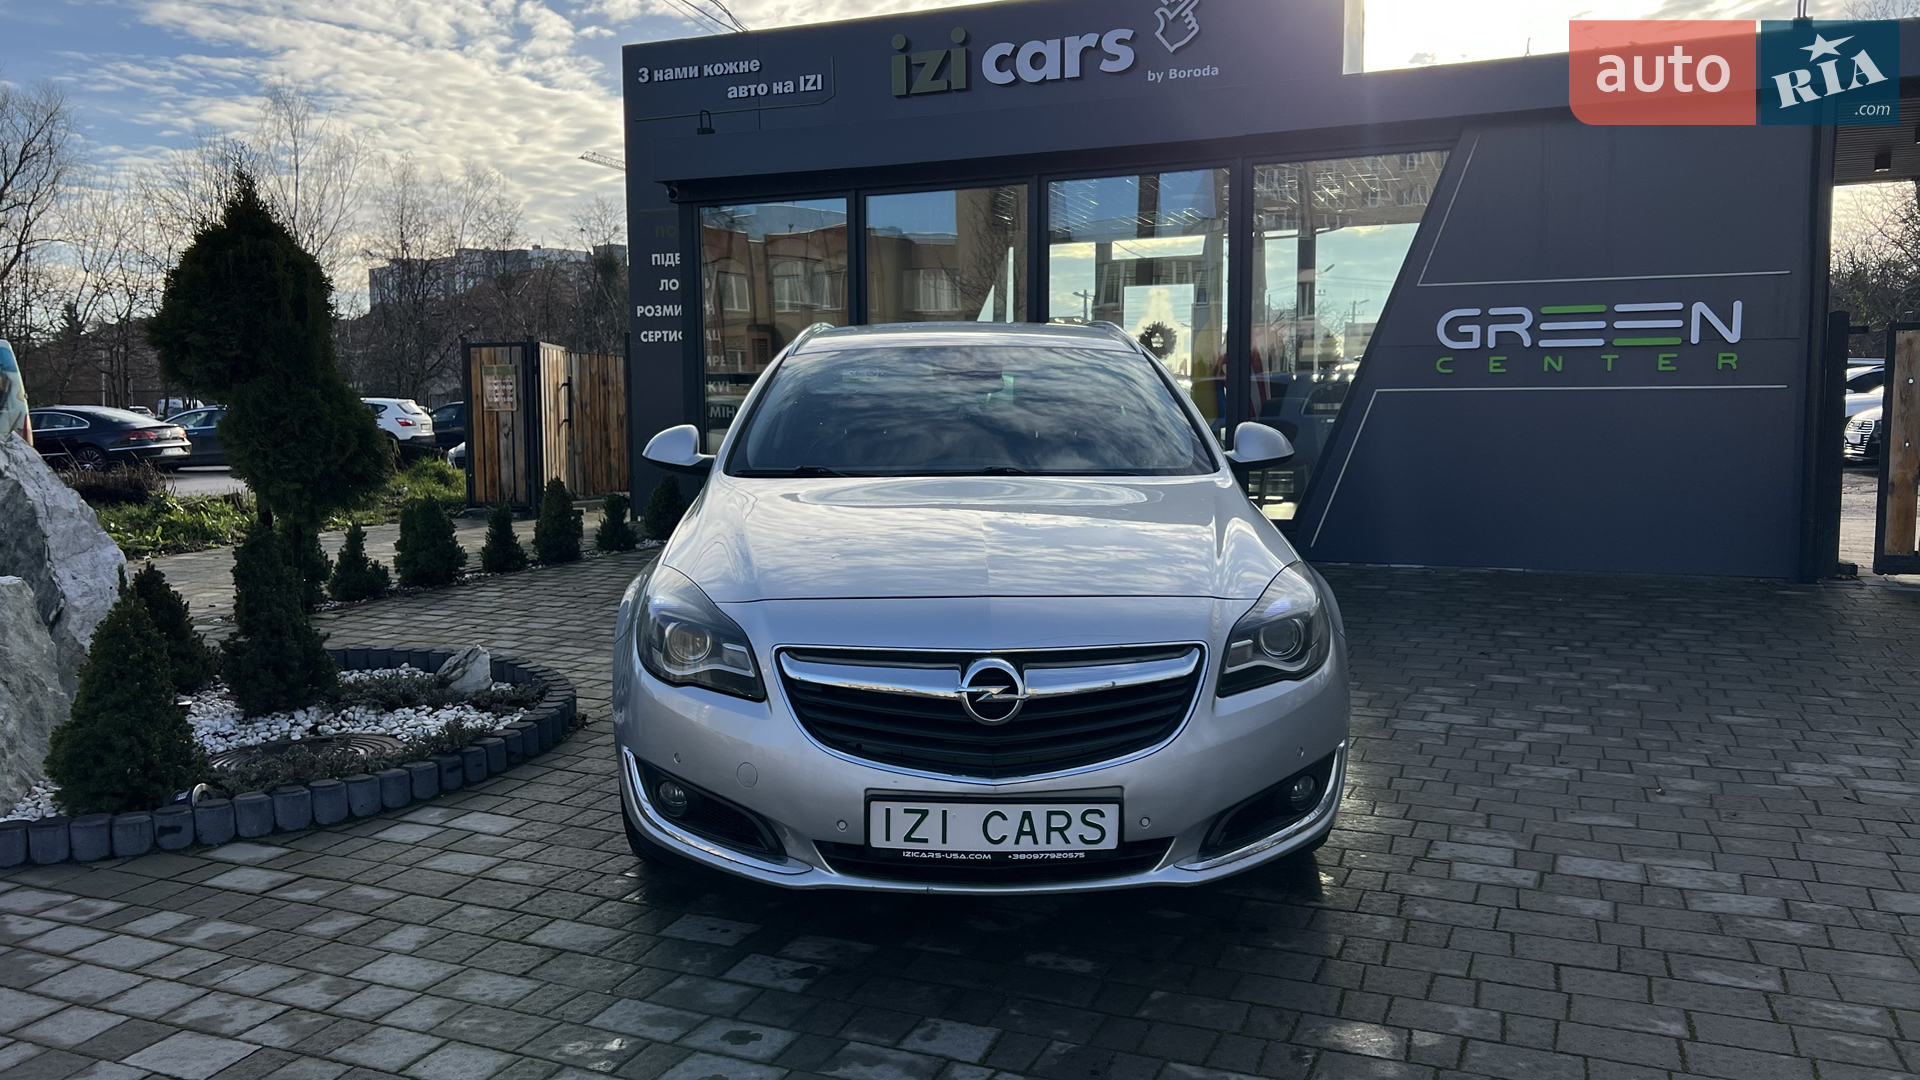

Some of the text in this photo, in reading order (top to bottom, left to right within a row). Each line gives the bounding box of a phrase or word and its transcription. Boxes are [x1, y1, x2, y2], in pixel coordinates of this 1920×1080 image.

[653, 65, 699, 82] нами
[703, 59, 761, 77] кожне
[891, 26, 1136, 96] izi cars
[1147, 64, 1219, 83] by Boroda
[727, 74, 823, 99] авто на IZI
[1436, 300, 1743, 350] GREEN
[1435, 352, 1738, 373] CENTER
[884, 807, 1106, 845] IZI CARS
[902, 851, 992, 860] IZICARS-USA.COM
